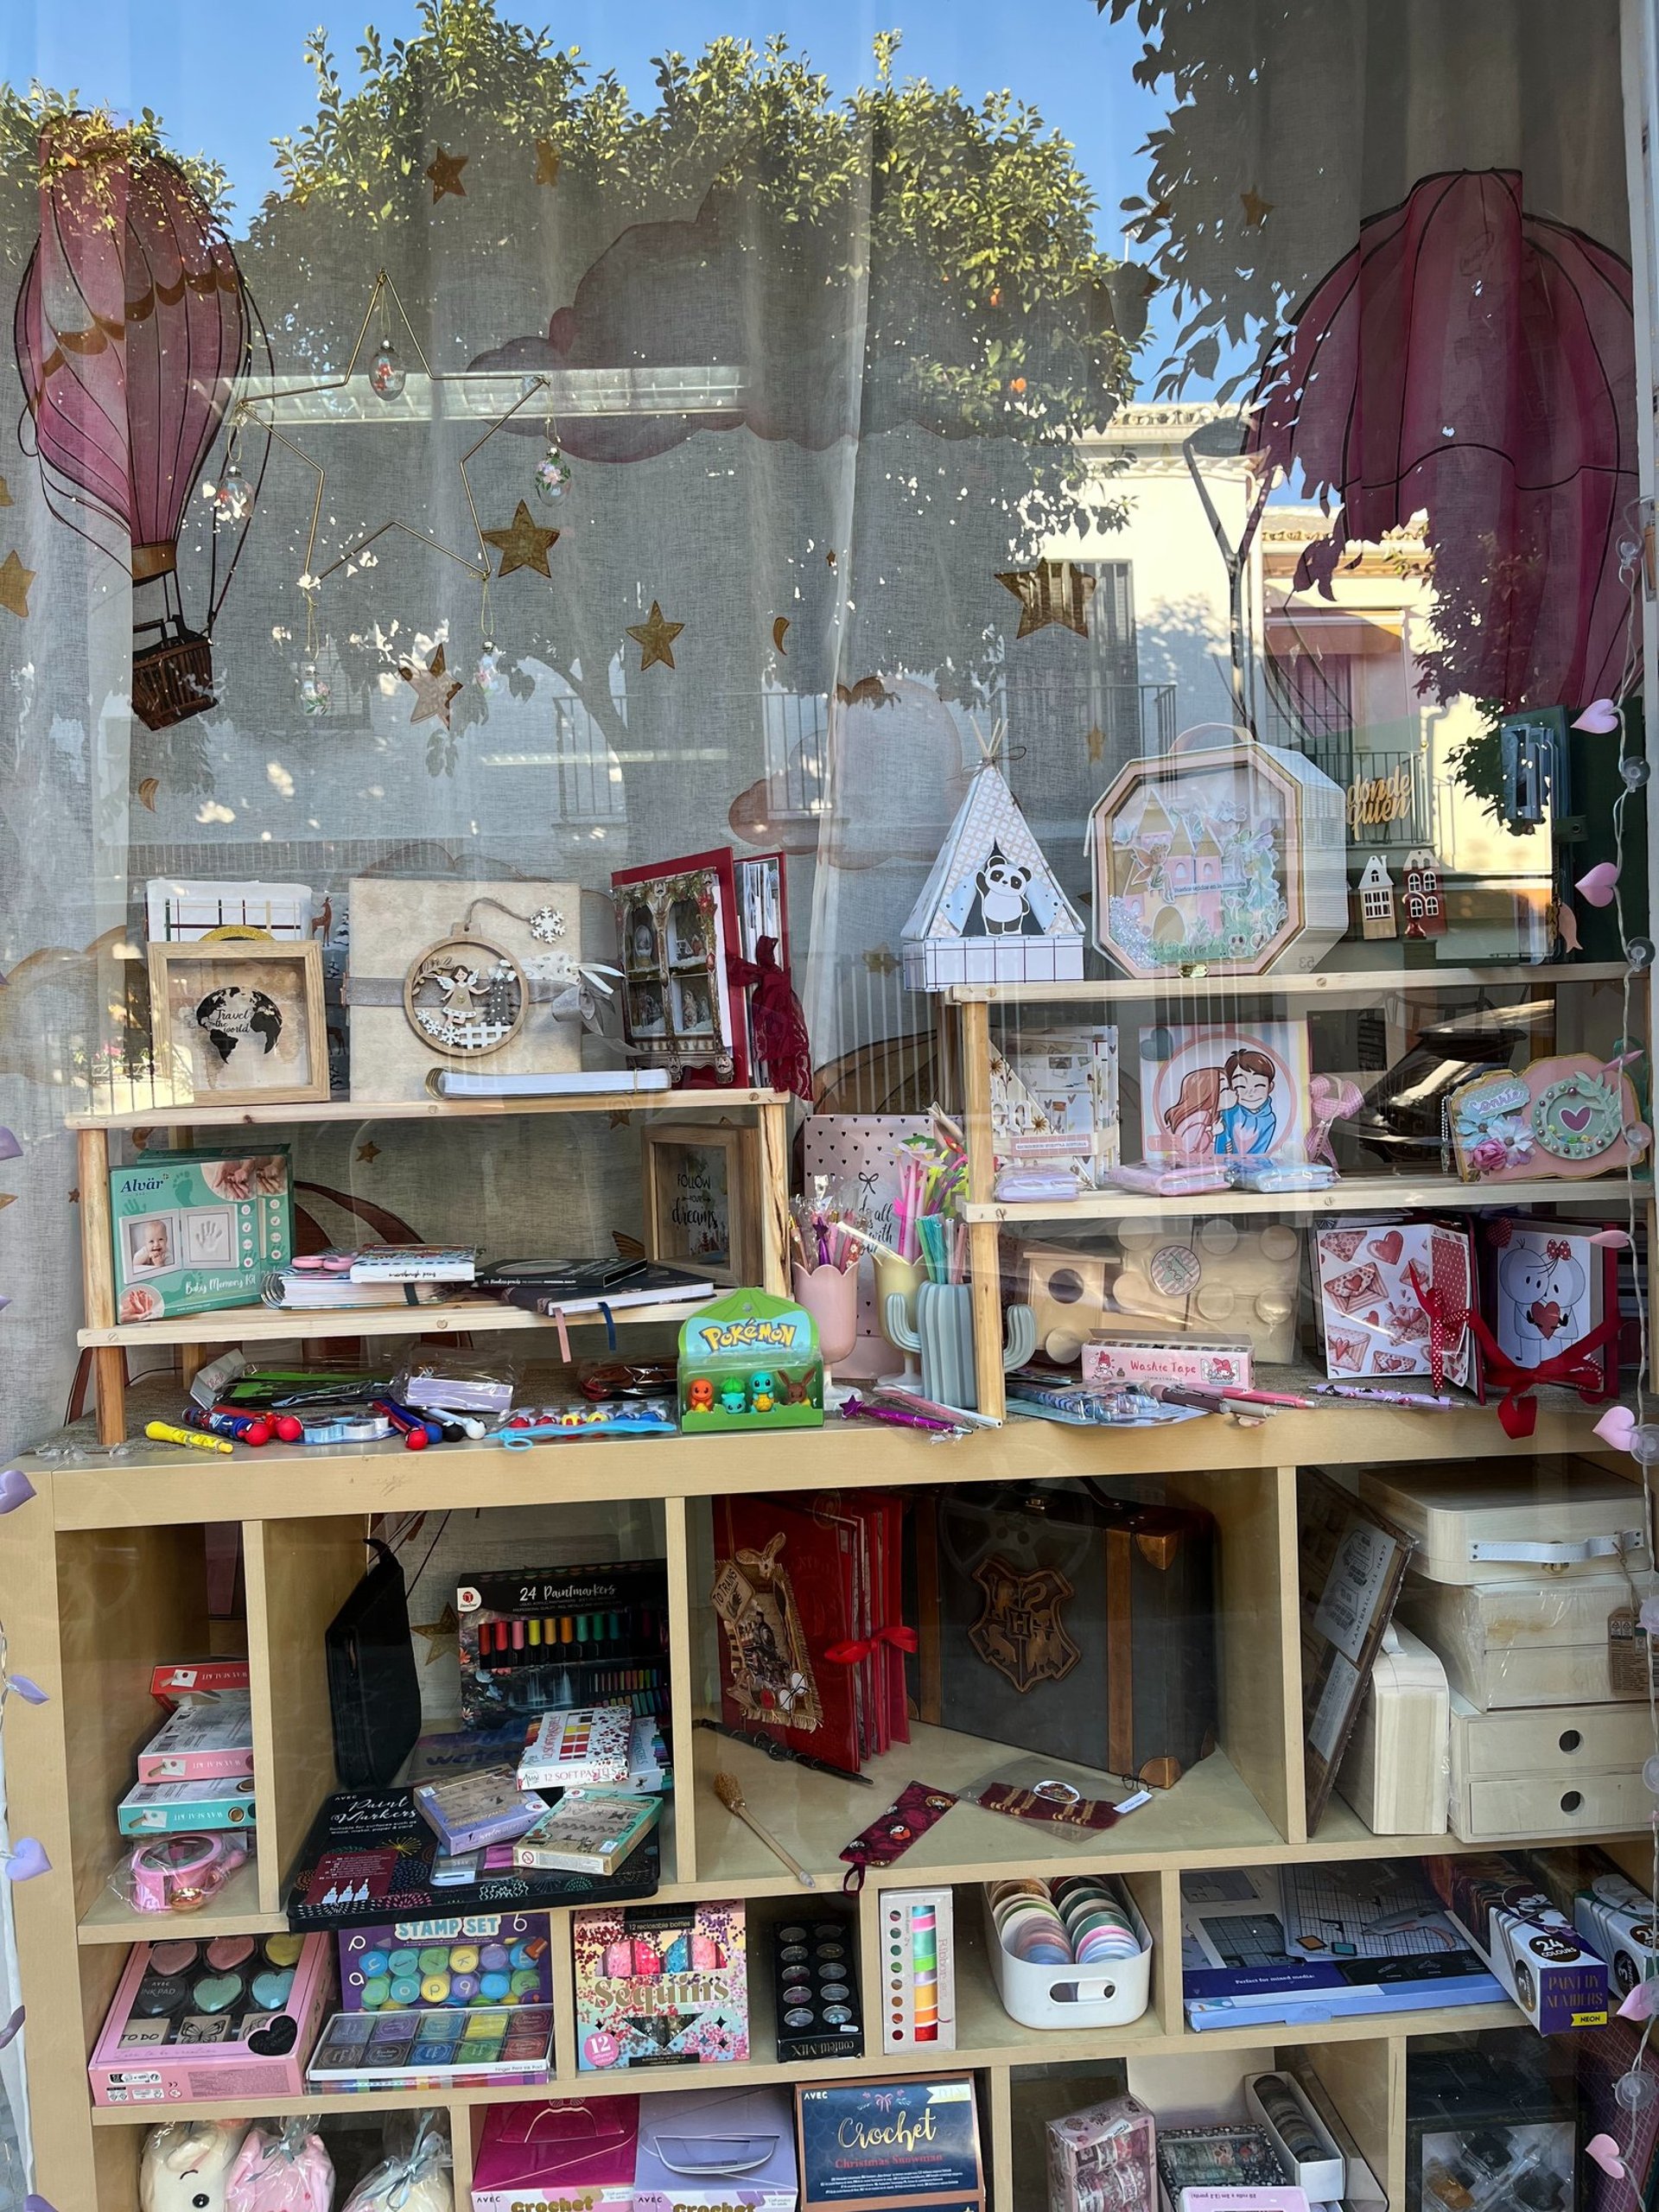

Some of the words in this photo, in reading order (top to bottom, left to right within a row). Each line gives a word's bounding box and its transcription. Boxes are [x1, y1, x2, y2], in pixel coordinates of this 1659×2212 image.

[217, 1009, 250, 1020] Travel
[224, 1023, 250, 1033] world
[120, 1177, 164, 1194] Alvär
[677, 1173, 711, 1190] FOLLOW
[672, 1197, 719, 1230] dreams
[874, 1204, 893, 1223] all
[185, 1281, 207, 1295] Baby
[209, 1277, 244, 1292] Memory
[245, 1274, 256, 1285] Kit
[1170, 1361, 1197, 1377] Tape
[519, 1586, 537, 1602] 24
[543, 1583, 617, 1600] Paintmarkers
[713, 1590, 724, 1607] TO
[720, 1568, 739, 1594] TRAINS
[1012, 1612, 1030, 1635] H
[543, 1773, 554, 1782] 12
[555, 1771, 580, 1781] SOFT
[581, 1768, 617, 1779] PASTELS
[347, 1796, 410, 1813] Paint
[330, 1808, 416, 1824] Markers
[397, 1919, 459, 1937] STAMP
[465, 1916, 499, 1934] SET
[1535, 1938, 1565, 1952] 24
[1541, 1947, 1577, 1958] COLOURS
[349, 1972, 365, 1986] a
[1618, 1967, 1628, 1980] 3
[430, 1984, 441, 1997] p
[1517, 1975, 1527, 1990] 3
[1548, 1975, 1582, 1992] PAINT
[1585, 1975, 1599, 1989] BY
[594, 1974, 729, 2014] Sequins
[1546, 1993, 1604, 2008] NUMBERS
[121, 2033, 138, 2042] TO
[589, 2035, 612, 2055] 12
[791, 2043, 817, 2056] MIX
[804, 2091, 829, 2101] AVEC
[838, 2107, 937, 2152] Crochet
[835, 2157, 890, 2170] Christmas
[891, 2153, 944, 2165] Snowman
[510, 2196, 594, 2212] Crochet
